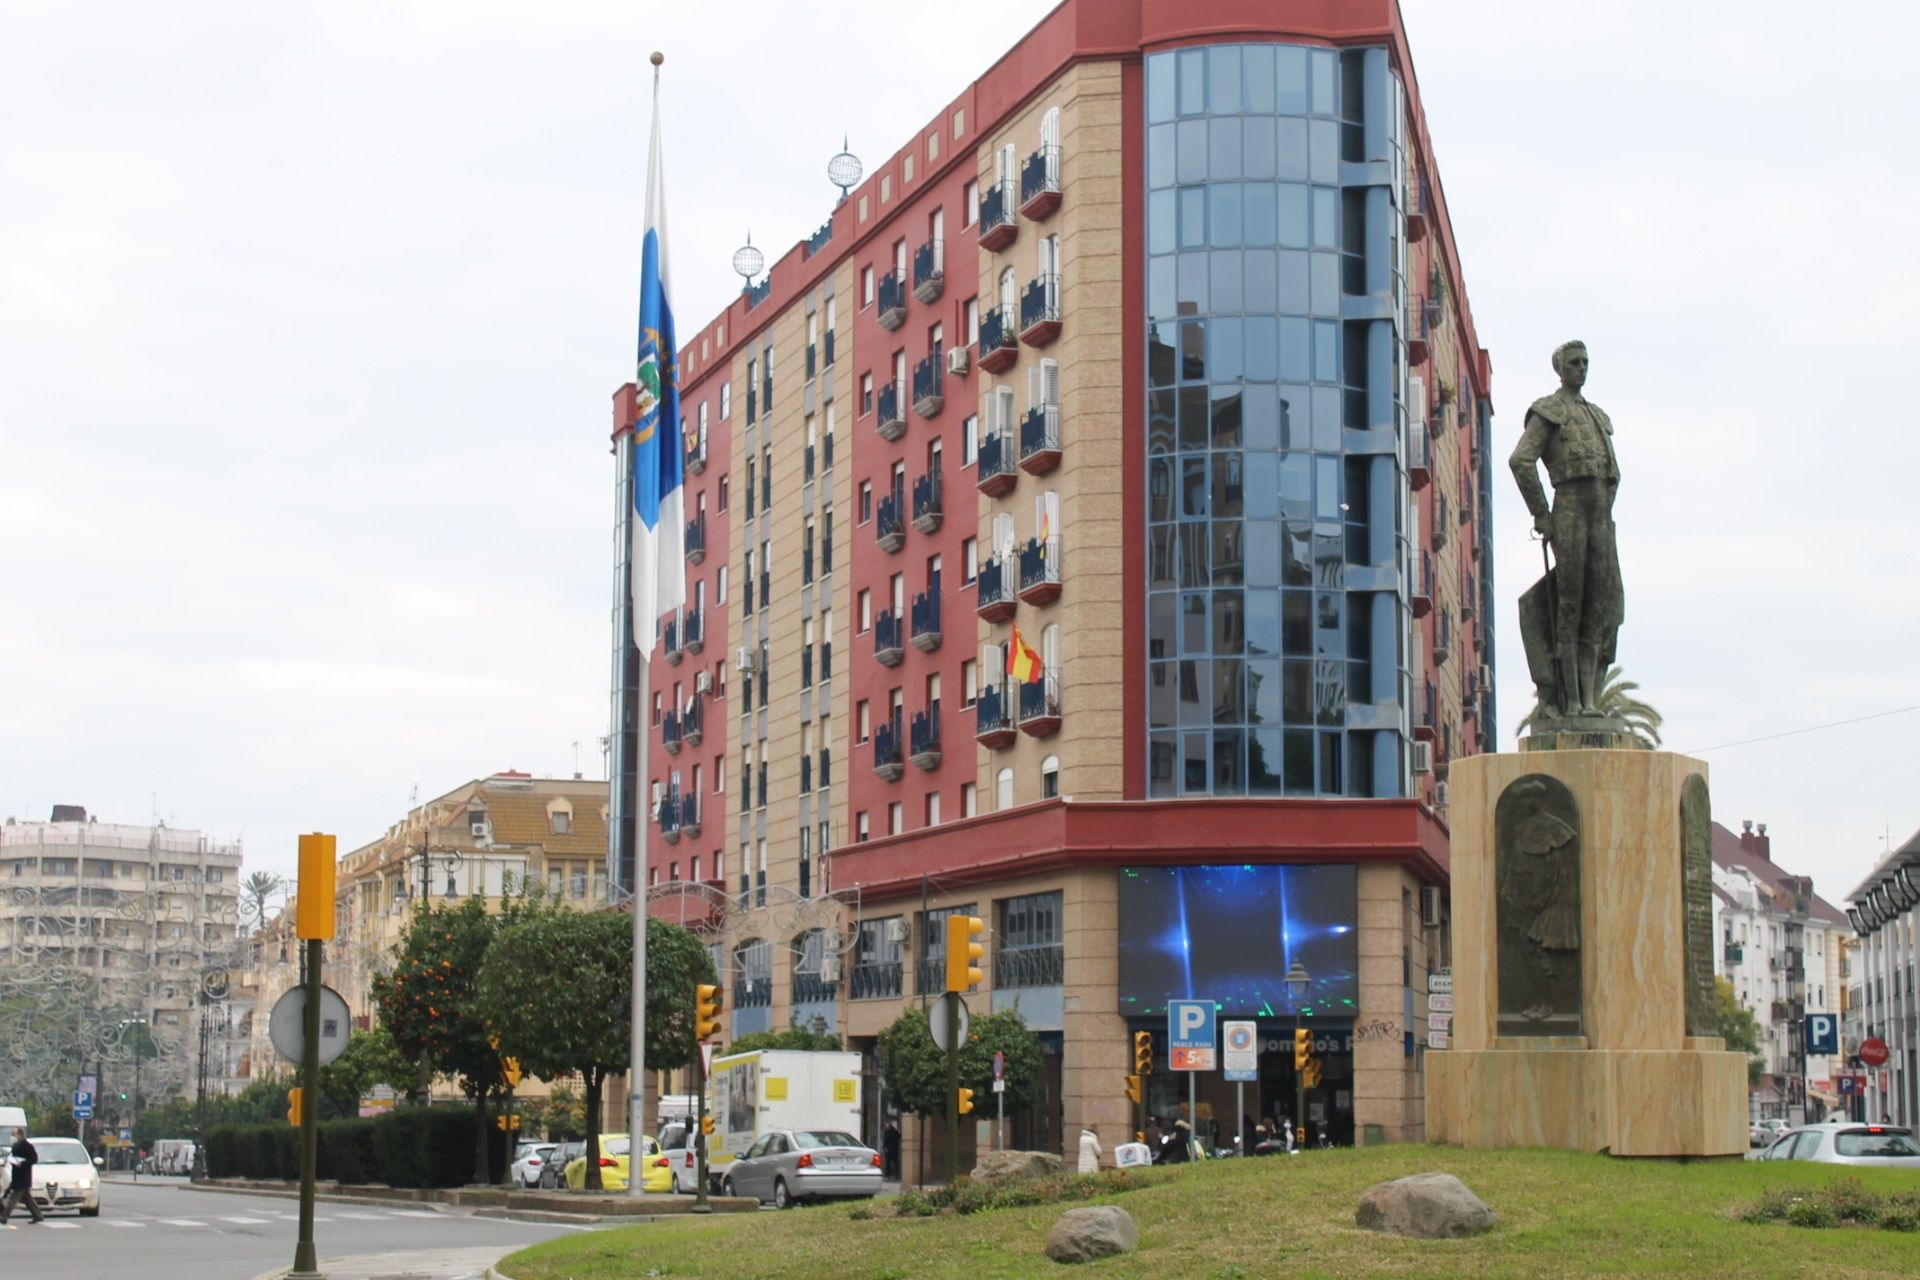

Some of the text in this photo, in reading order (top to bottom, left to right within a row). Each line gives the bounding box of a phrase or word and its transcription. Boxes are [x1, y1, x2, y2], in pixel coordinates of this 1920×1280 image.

[1180, 1005, 1205, 1039] P
[1812, 1016, 1831, 1045] P
[1842, 1079, 1851, 1090] P
[78, 1092, 88, 1105] P
